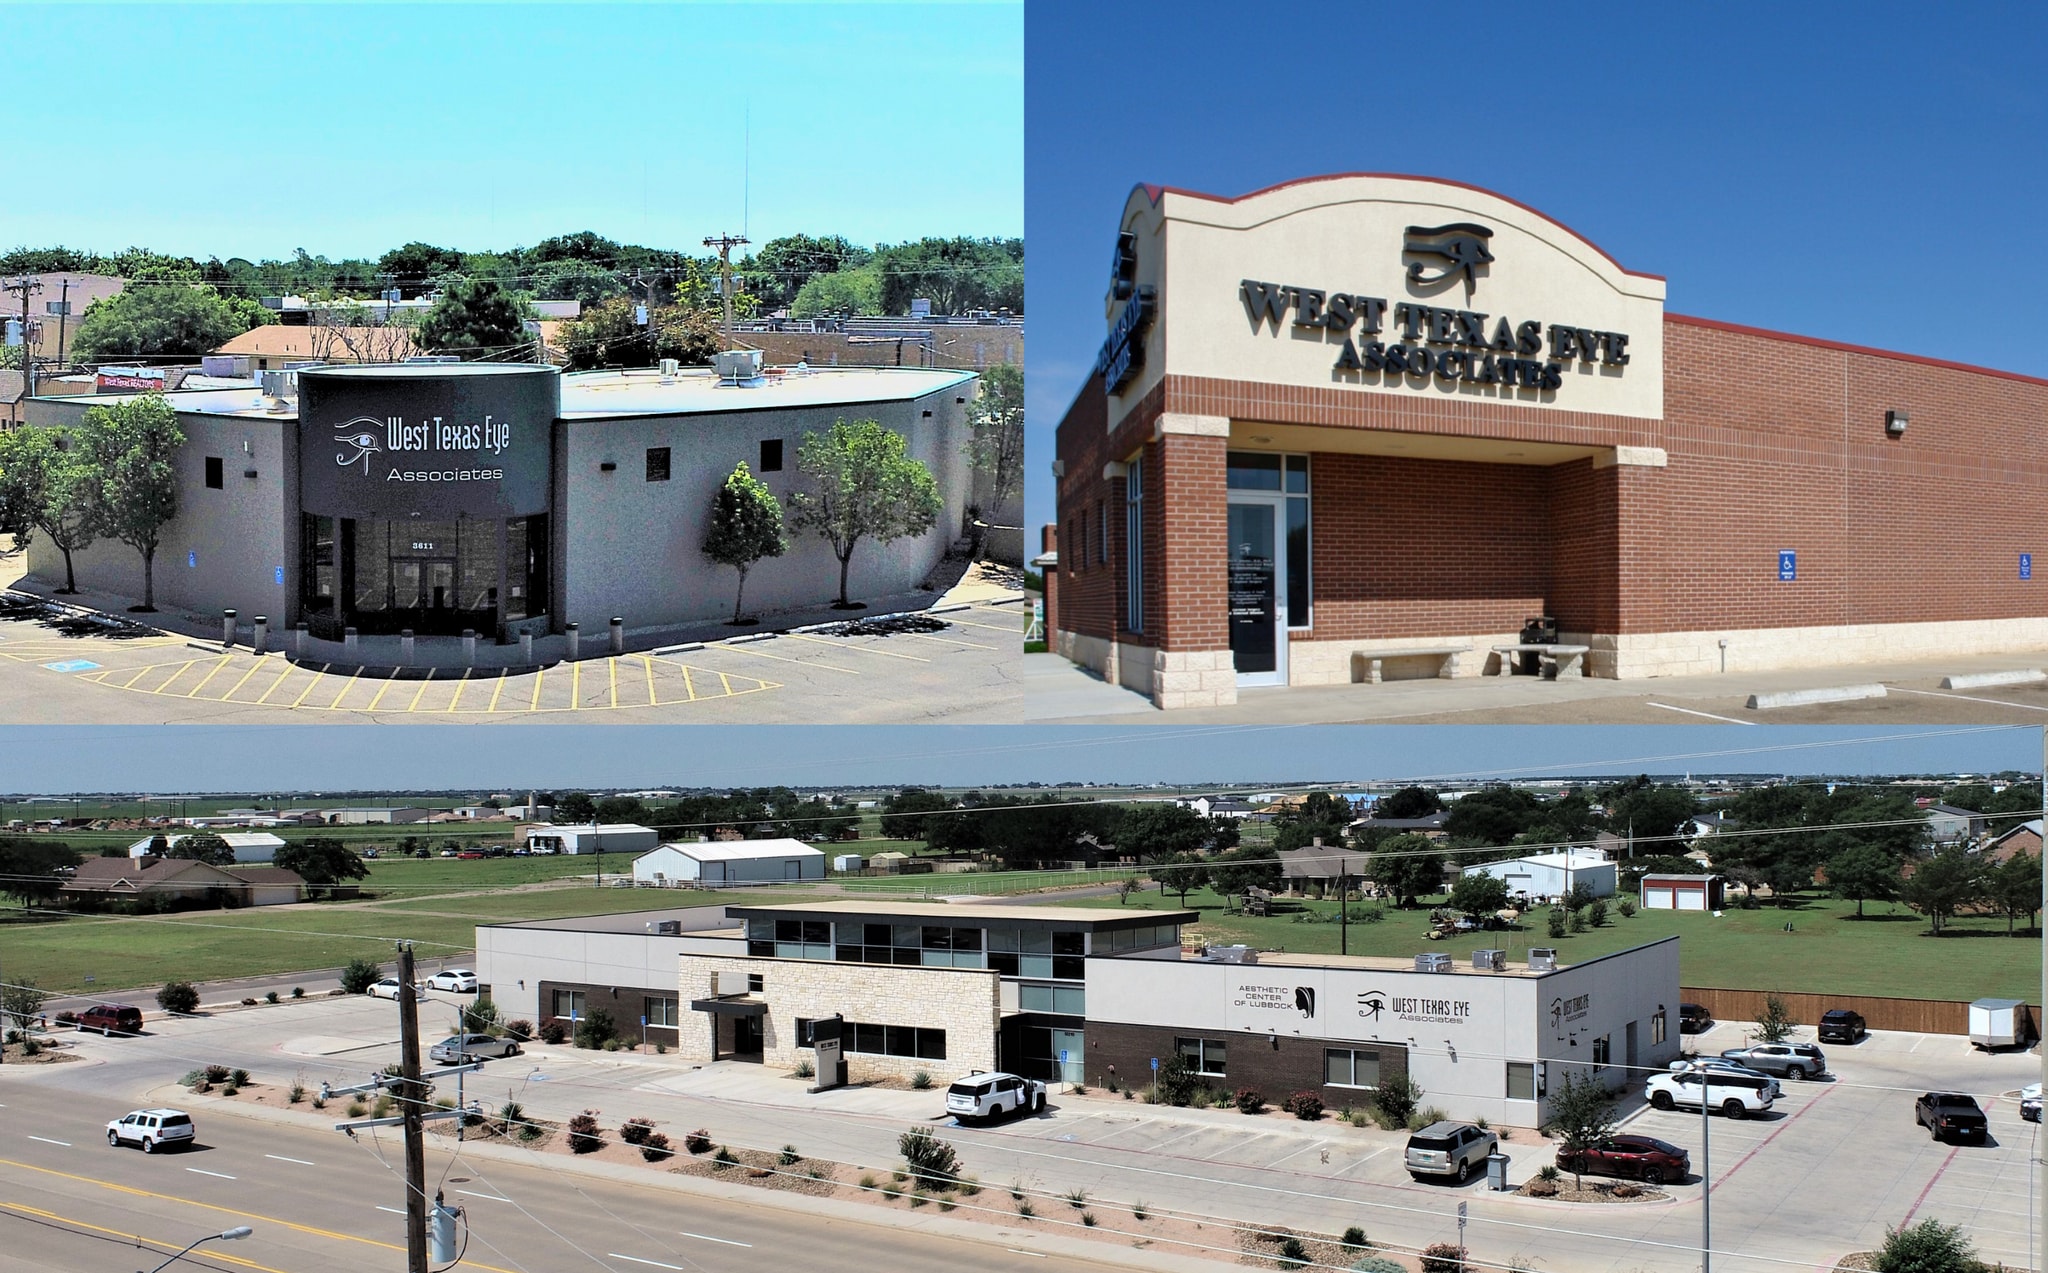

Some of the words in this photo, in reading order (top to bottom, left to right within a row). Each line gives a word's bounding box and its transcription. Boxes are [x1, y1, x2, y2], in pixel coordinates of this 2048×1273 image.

[1240, 279, 1387, 334] WEST
[1395, 301, 1542, 355] TEXAS
[1549, 323, 1630, 366] EYE
[1335, 339, 1563, 391] ASSOCIATES
[387, 416, 430, 451] West
[433, 416, 481, 451] Texas
[485, 415, 510, 455] Eye
[386, 467, 503, 482] Associates
[412, 542, 434, 550] 3611
[1239, 985, 1289, 994] AESTHETIC
[1245, 993, 1282, 1001] CENTER
[1249, 1001, 1294, 1010] LUBBOCK
[1392, 997, 1418, 1013] WEST
[1420, 998, 1450, 1016] TEXAS
[1453, 1001, 1470, 1017] EYE
[1399, 1013, 1464, 1024] Associates
